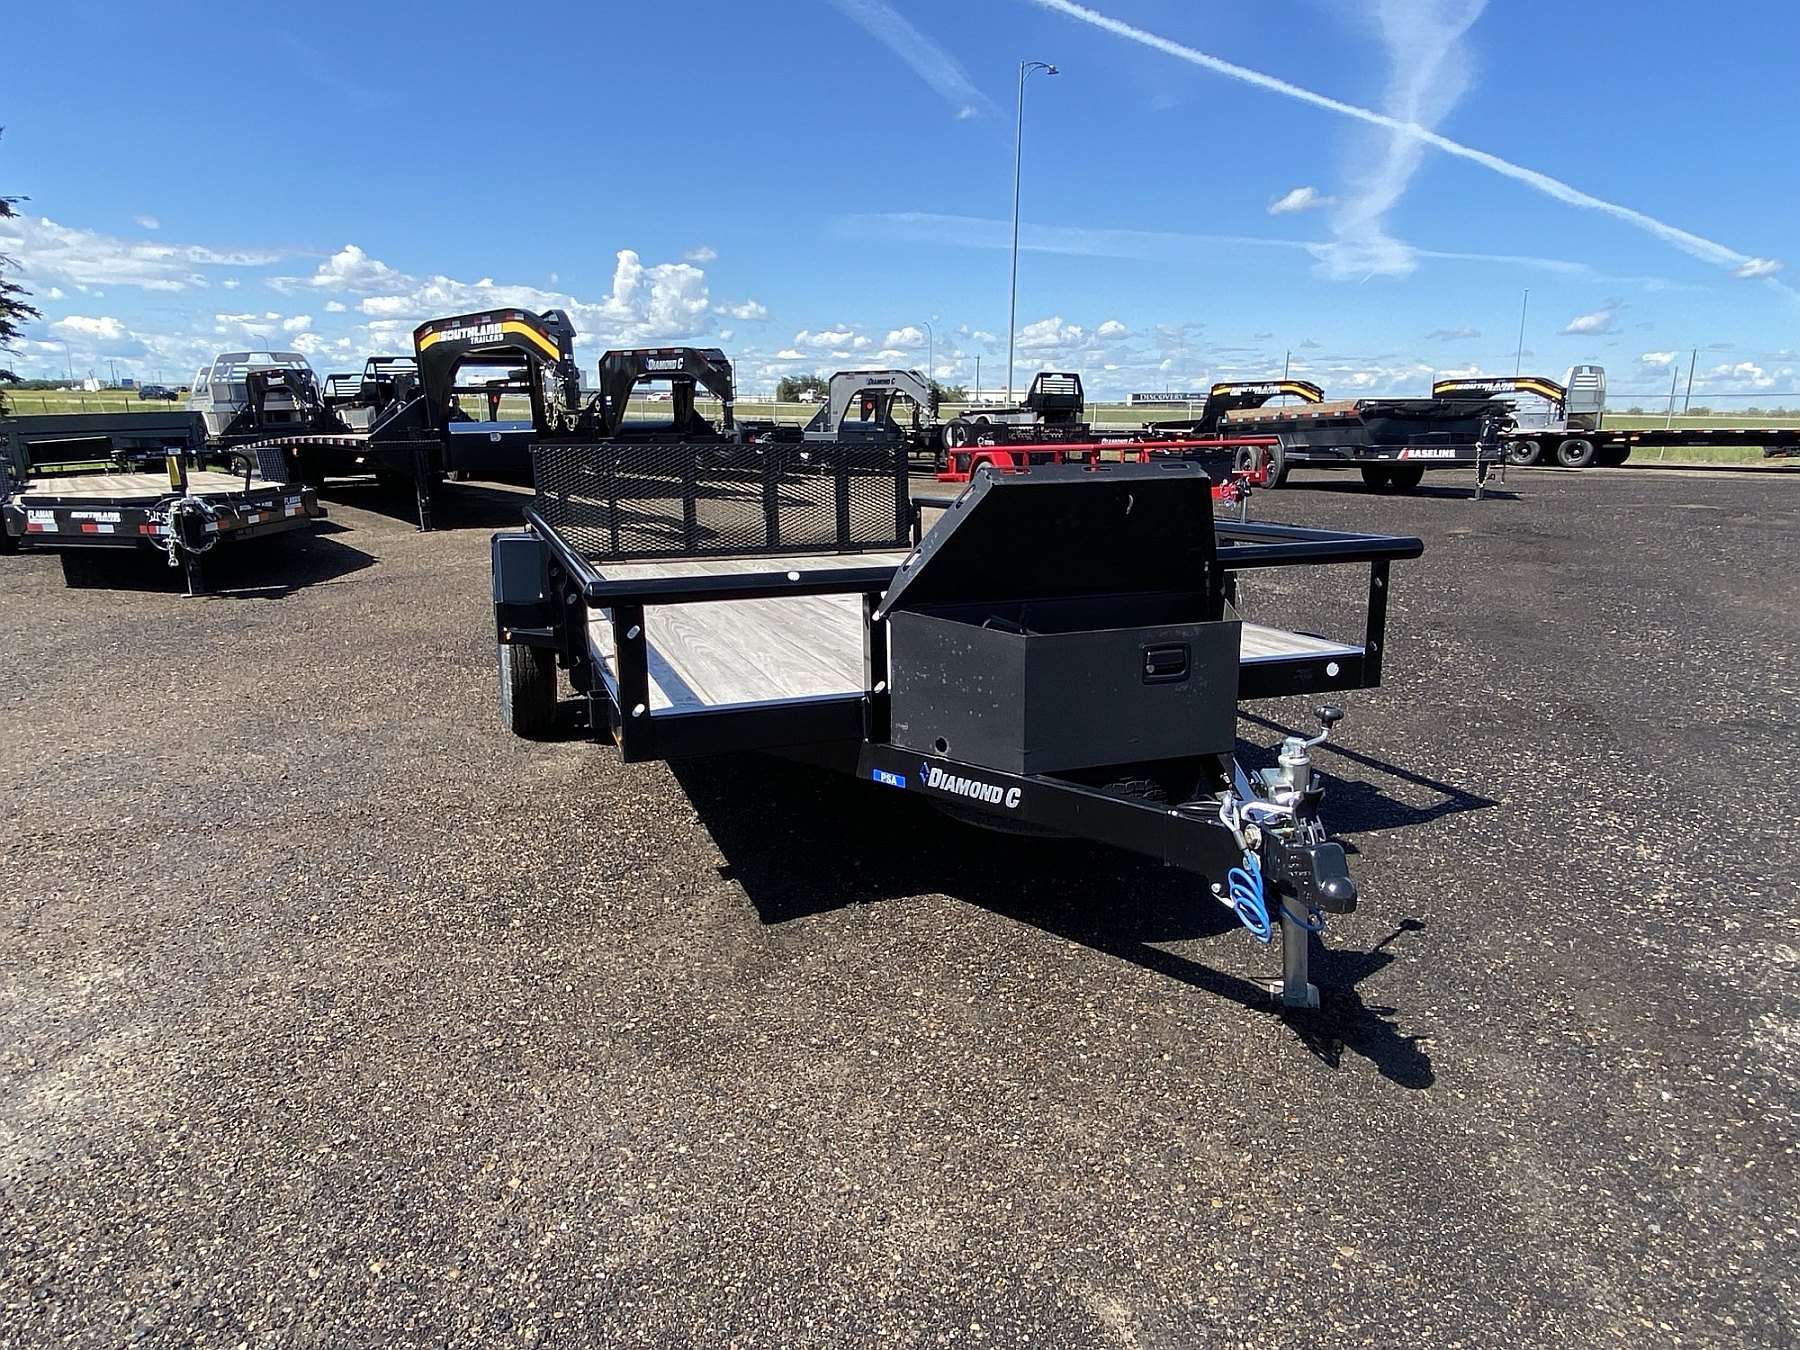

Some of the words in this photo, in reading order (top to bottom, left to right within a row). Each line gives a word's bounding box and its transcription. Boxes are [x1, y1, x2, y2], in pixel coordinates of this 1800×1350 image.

[440, 323, 503, 341] SOUTHLAND
[470, 334, 504, 345] TRAILERS
[648, 359, 677, 370] DIAMOND
[677, 357, 684, 370] C
[1139, 393, 1184, 401] DISCOVERY
[1407, 449, 1456, 459] BASELINE
[880, 771, 897, 786] PSA
[927, 767, 1004, 804] DIAMOND
[1005, 787, 1022, 809] C
